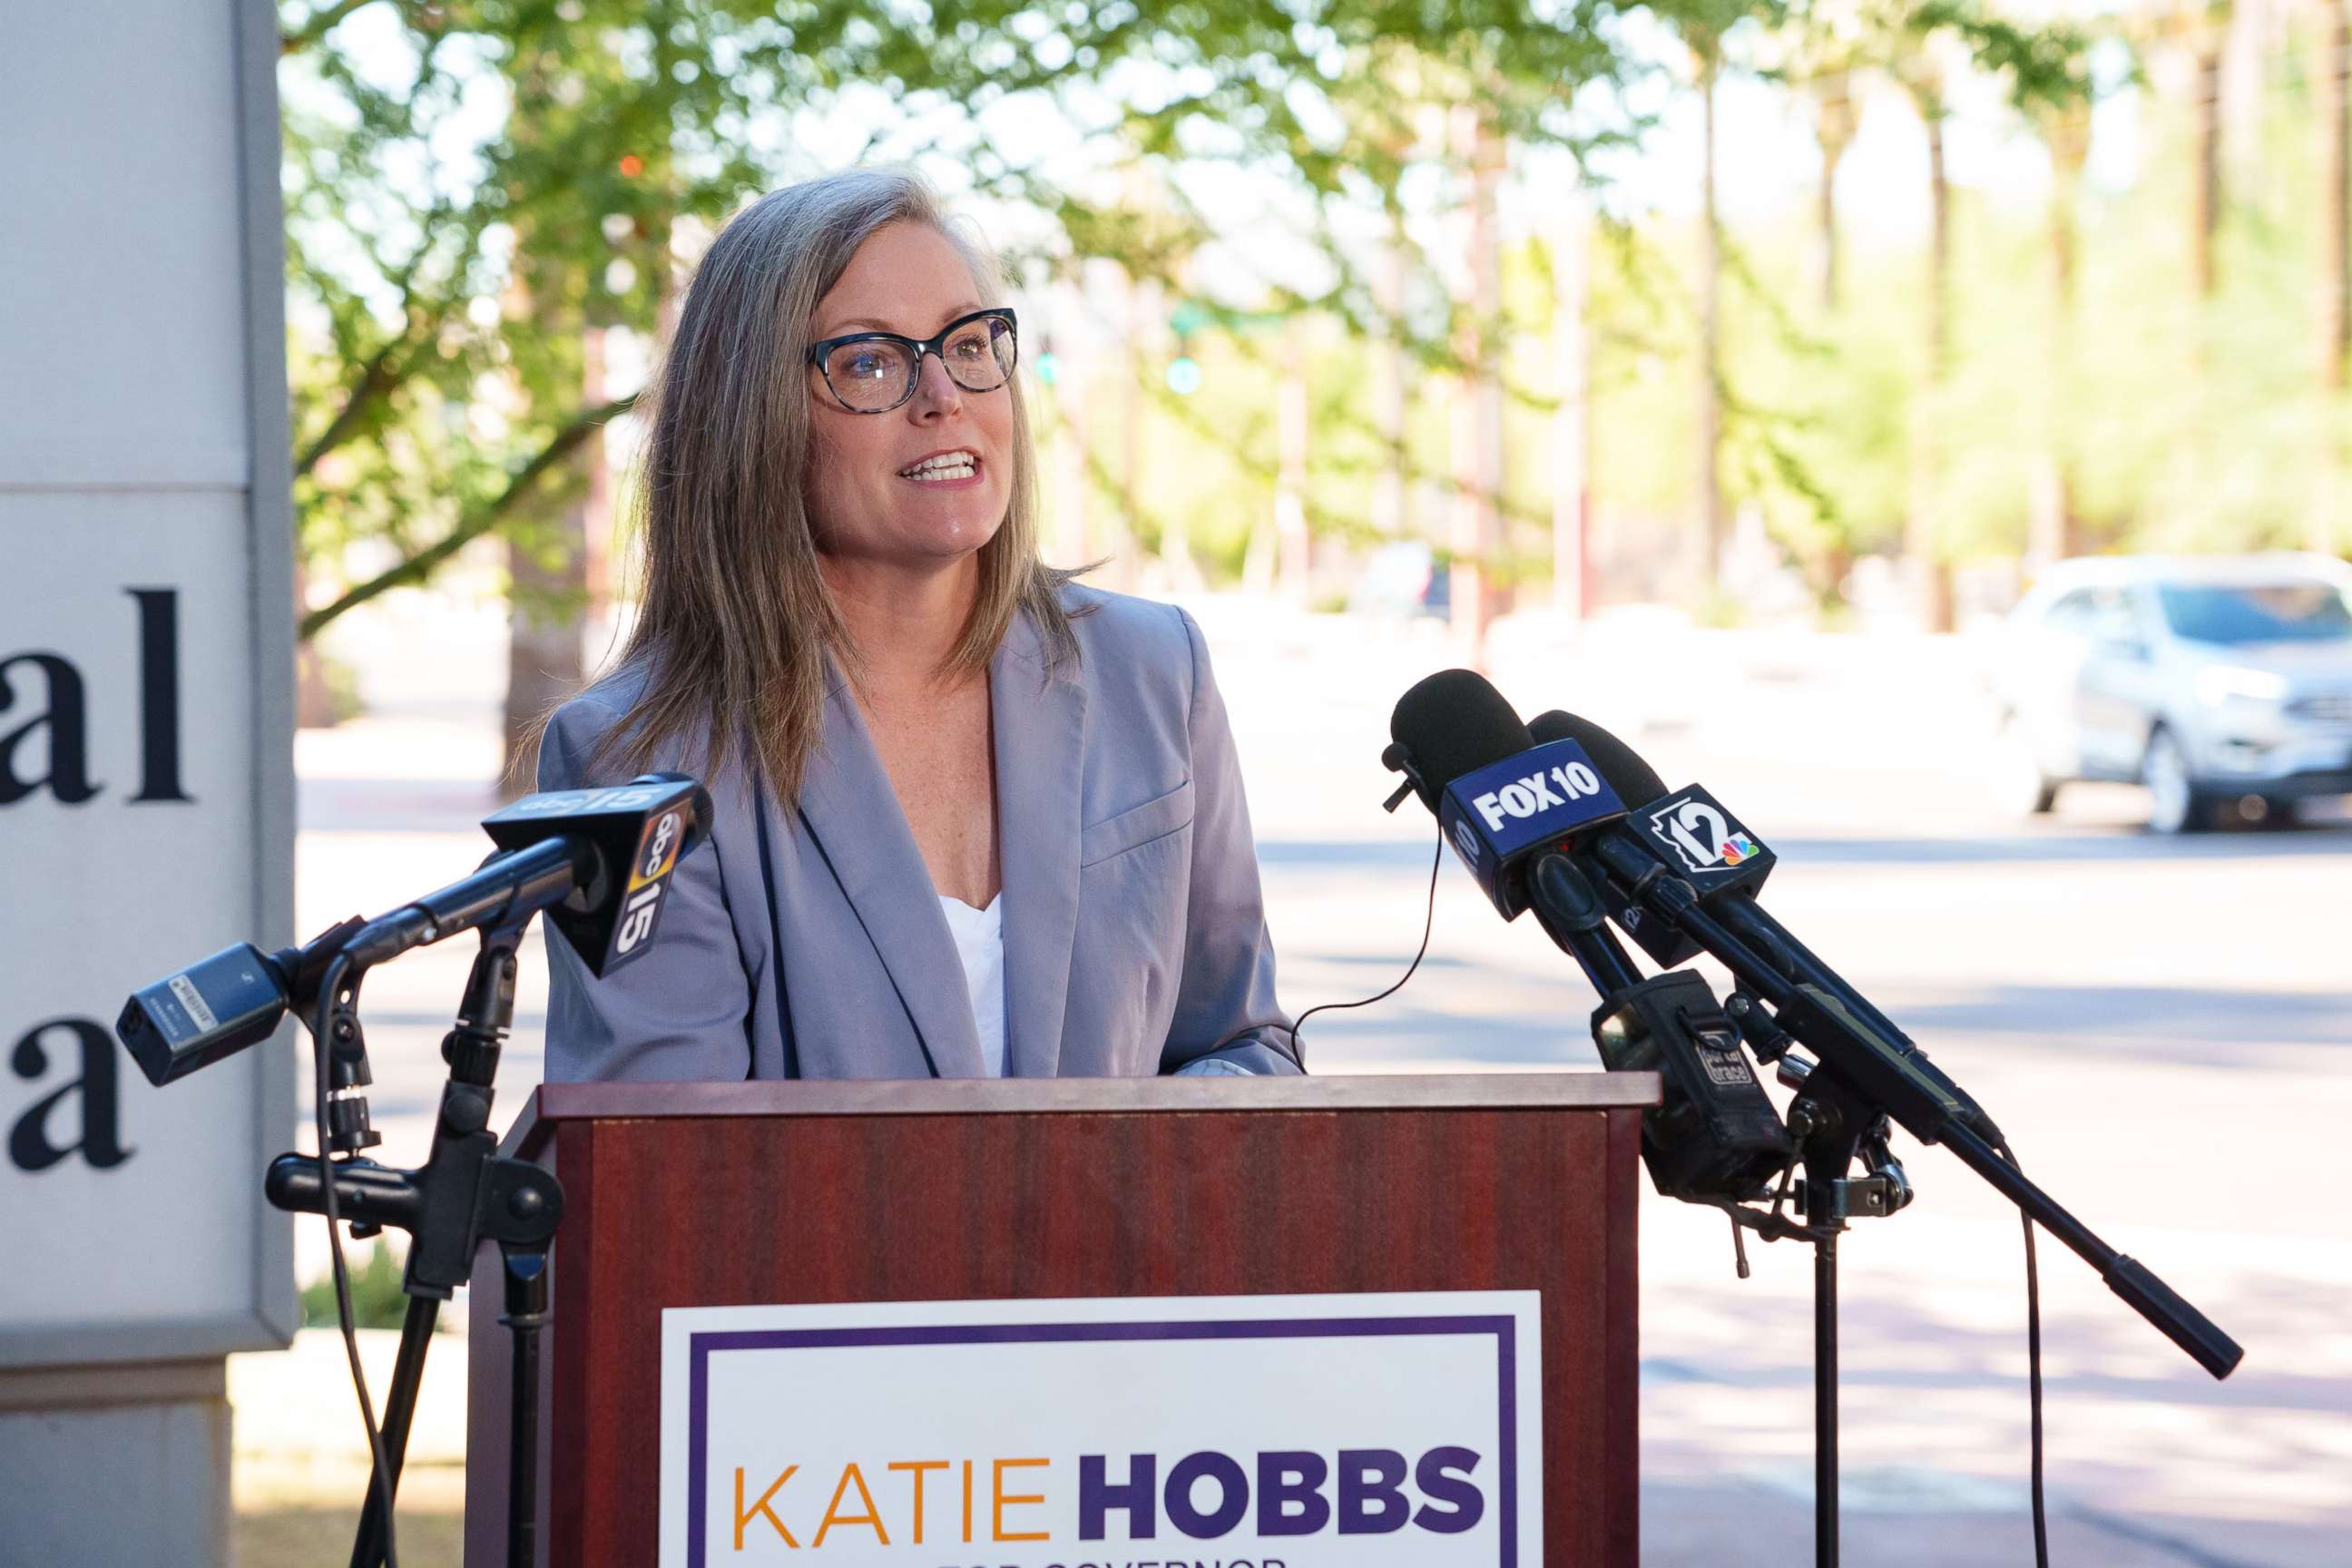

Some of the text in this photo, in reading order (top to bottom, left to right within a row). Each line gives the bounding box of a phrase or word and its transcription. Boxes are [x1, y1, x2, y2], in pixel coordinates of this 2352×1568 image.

[0, 589, 197, 806] al
[583, 788, 663, 810] 15
[1472, 761, 1600, 832] FOX 10
[1670, 802, 1752, 867] 12
[617, 813, 674, 953] abc 15
[7, 1018, 138, 1173] a
[733, 1446, 1485, 1551] KATIE HOBBS
